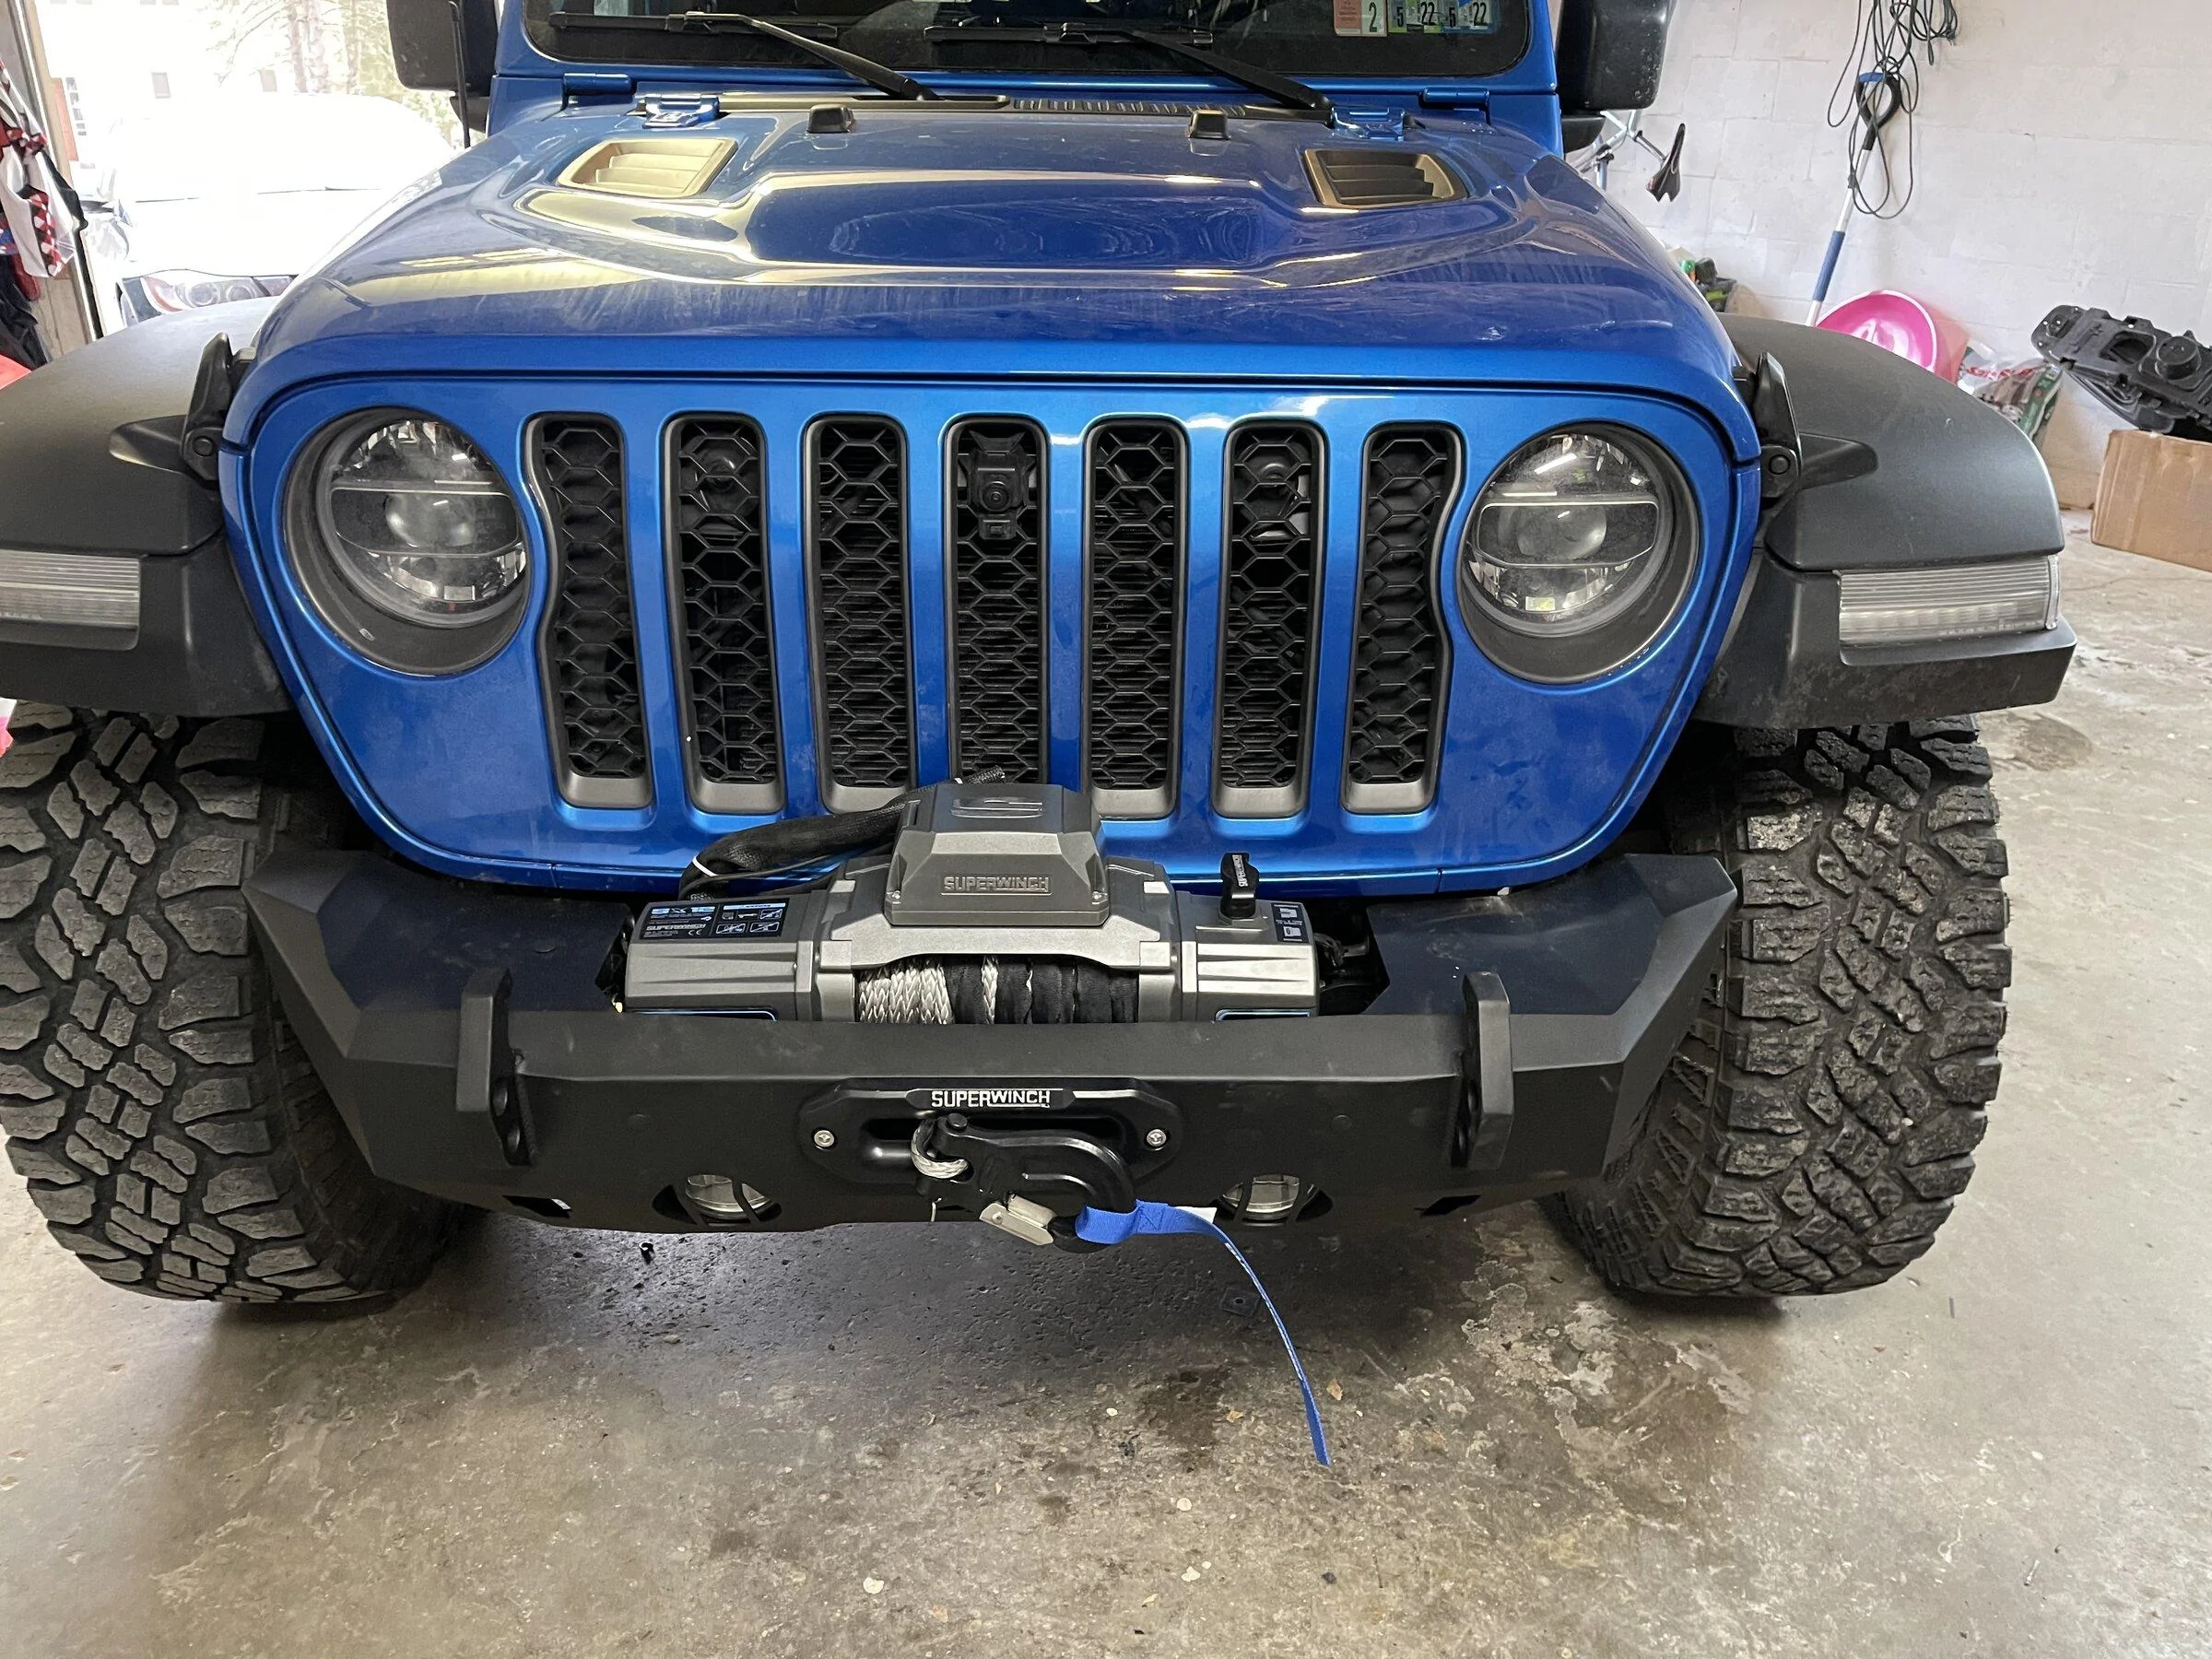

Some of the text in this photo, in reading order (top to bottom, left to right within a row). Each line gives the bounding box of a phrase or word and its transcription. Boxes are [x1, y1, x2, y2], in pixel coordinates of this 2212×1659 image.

[1369, 2, 1378, 32] 2
[1396, 2, 1436, 27] 5 22
[1449, 2, 1487, 27] 5 22
[943, 877, 1050, 893] SUPERWINCH
[931, 1090, 1050, 1108] SUPERWINCH
